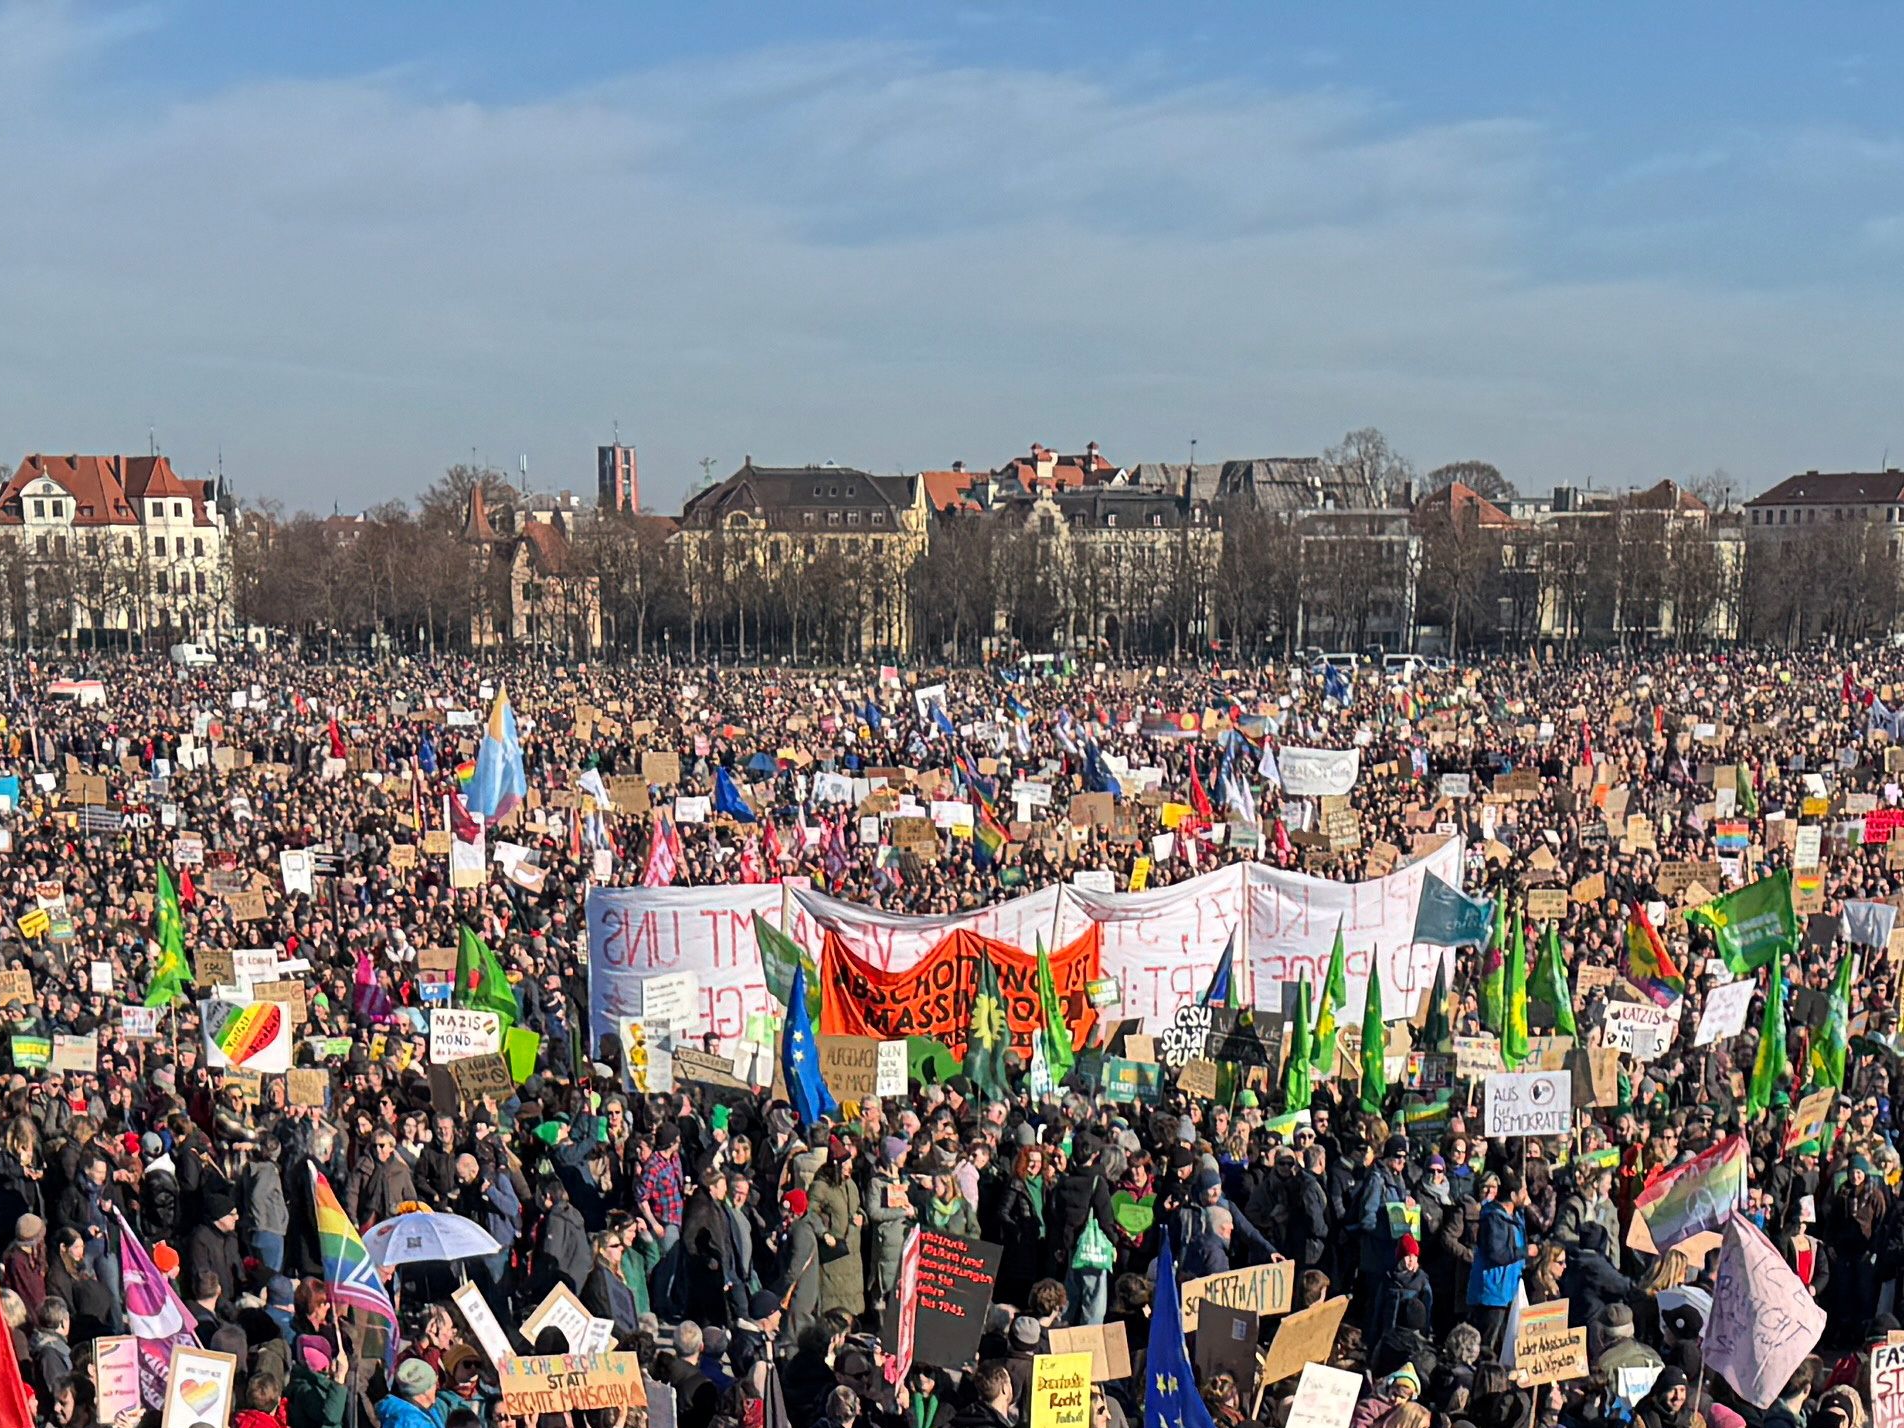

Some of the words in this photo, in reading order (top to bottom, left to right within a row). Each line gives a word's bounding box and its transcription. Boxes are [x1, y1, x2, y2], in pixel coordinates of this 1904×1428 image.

[435, 1014, 483, 1031] NAZIS
[1176, 1006, 1213, 1027] CSU
[1493, 1087, 1520, 1102] AUS
[1491, 1111, 1573, 1134] DEMOKRATIE
[546, 1371, 589, 1390] STATT
[503, 1391, 555, 1414] RECHTE
[558, 1383, 630, 1411] MENSCHEN
